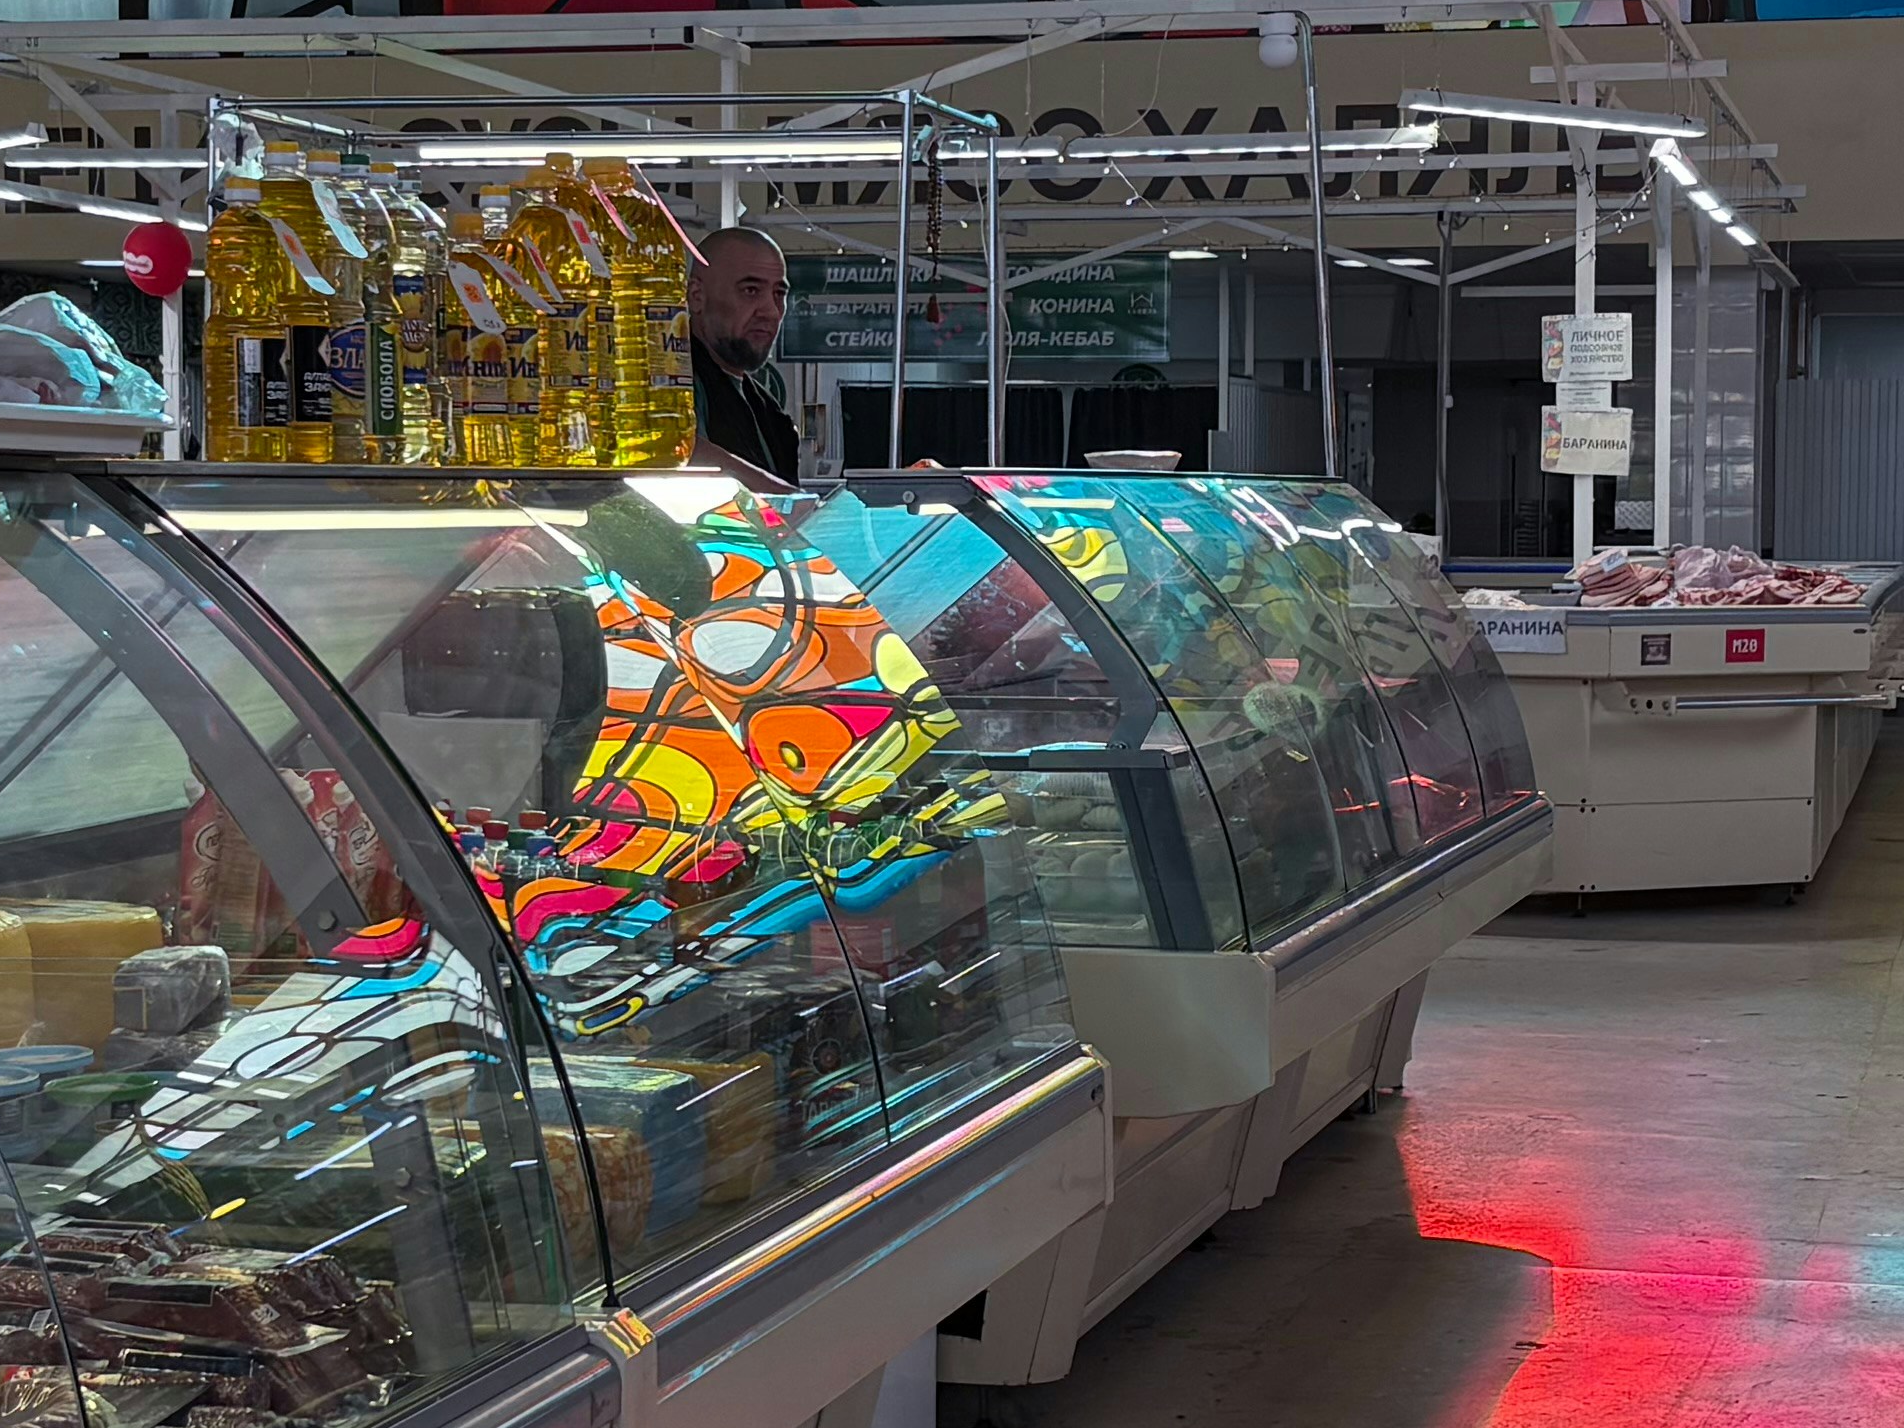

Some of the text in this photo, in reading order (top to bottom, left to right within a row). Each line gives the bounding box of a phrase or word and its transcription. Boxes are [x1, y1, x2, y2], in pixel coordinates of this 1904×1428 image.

[827, 267, 942, 284] ШАШЛКИ
[1030, 297, 1115, 314] КОНИНА
[977, 330, 1115, 347] ЛЛЯ-КЕБАБ
[1571, 330, 1624, 342] ЛИЧНОЕ
[380, 339, 394, 421] СЛОБОДА
[1562, 437, 1628, 451] БАРАНИНА
